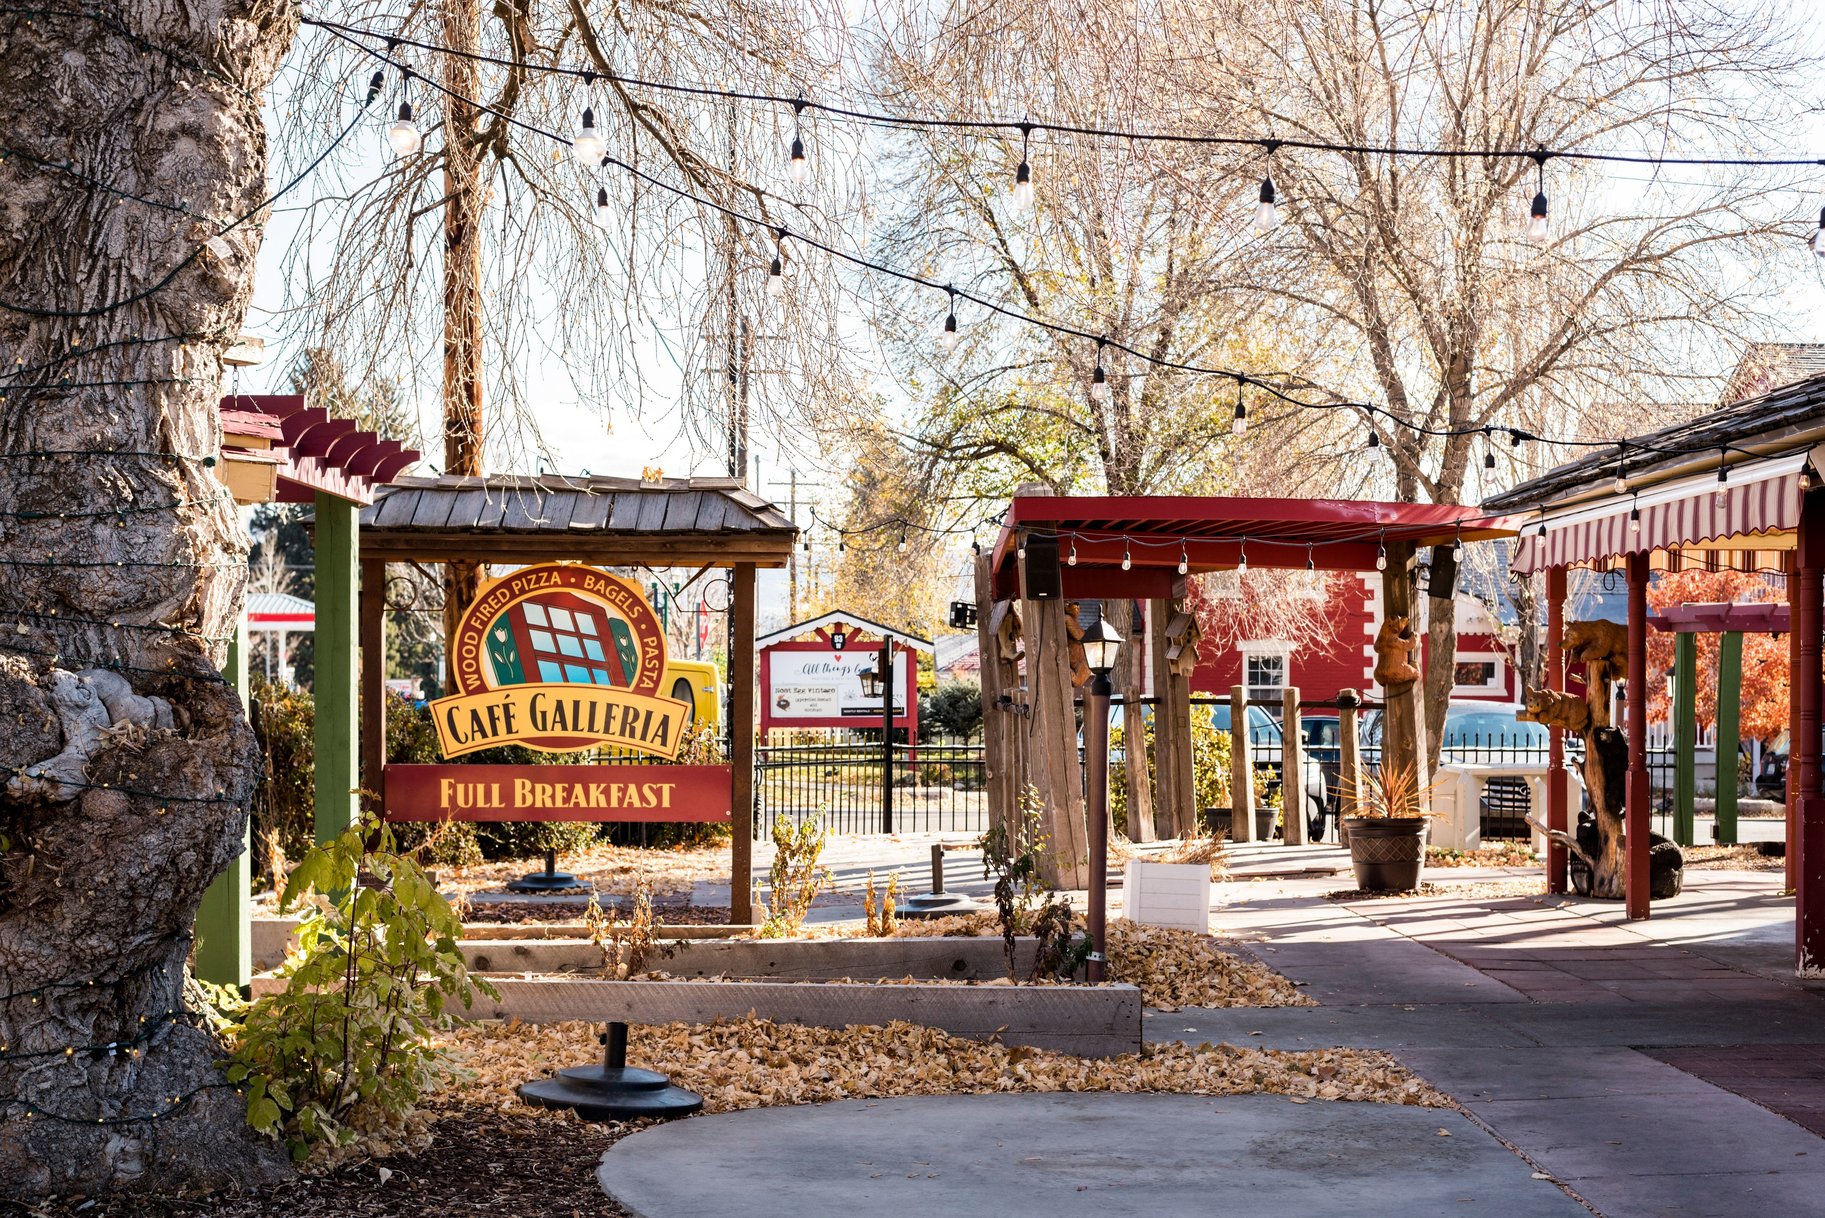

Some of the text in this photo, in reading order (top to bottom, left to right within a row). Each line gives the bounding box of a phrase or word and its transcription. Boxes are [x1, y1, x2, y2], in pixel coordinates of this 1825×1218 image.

[462, 571, 662, 691] WOOD FIRED PIZZA BAGELS PASTA
[834, 635, 843, 643] 93
[802, 662, 819, 675] All
[822, 662, 851, 676] things
[446, 692, 671, 748] CAFÉ GALLERIA
[440, 778, 676, 809] FULL BREAKFAST
